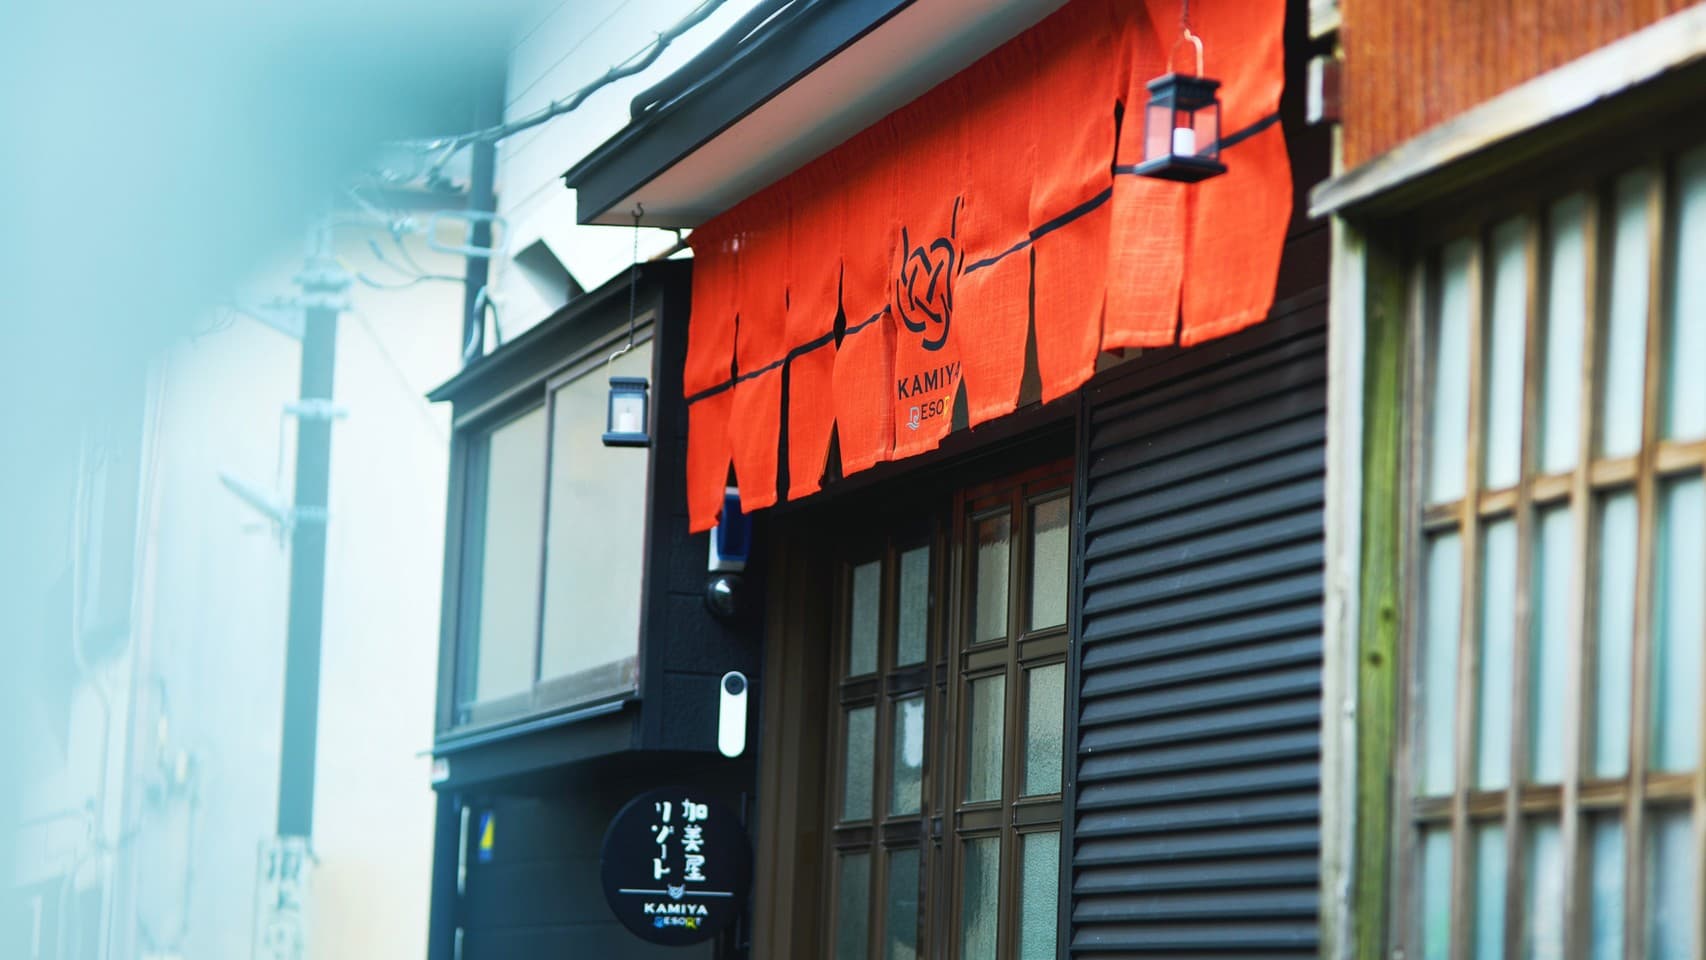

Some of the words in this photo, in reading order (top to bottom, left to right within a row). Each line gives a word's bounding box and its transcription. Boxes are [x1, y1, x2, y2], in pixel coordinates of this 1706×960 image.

[651, 801, 675, 880] リゾート
[681, 798, 708, 881] 加美屋
[644, 903, 708, 916] KAMIYA
[654, 916, 703, 929] RESORT
